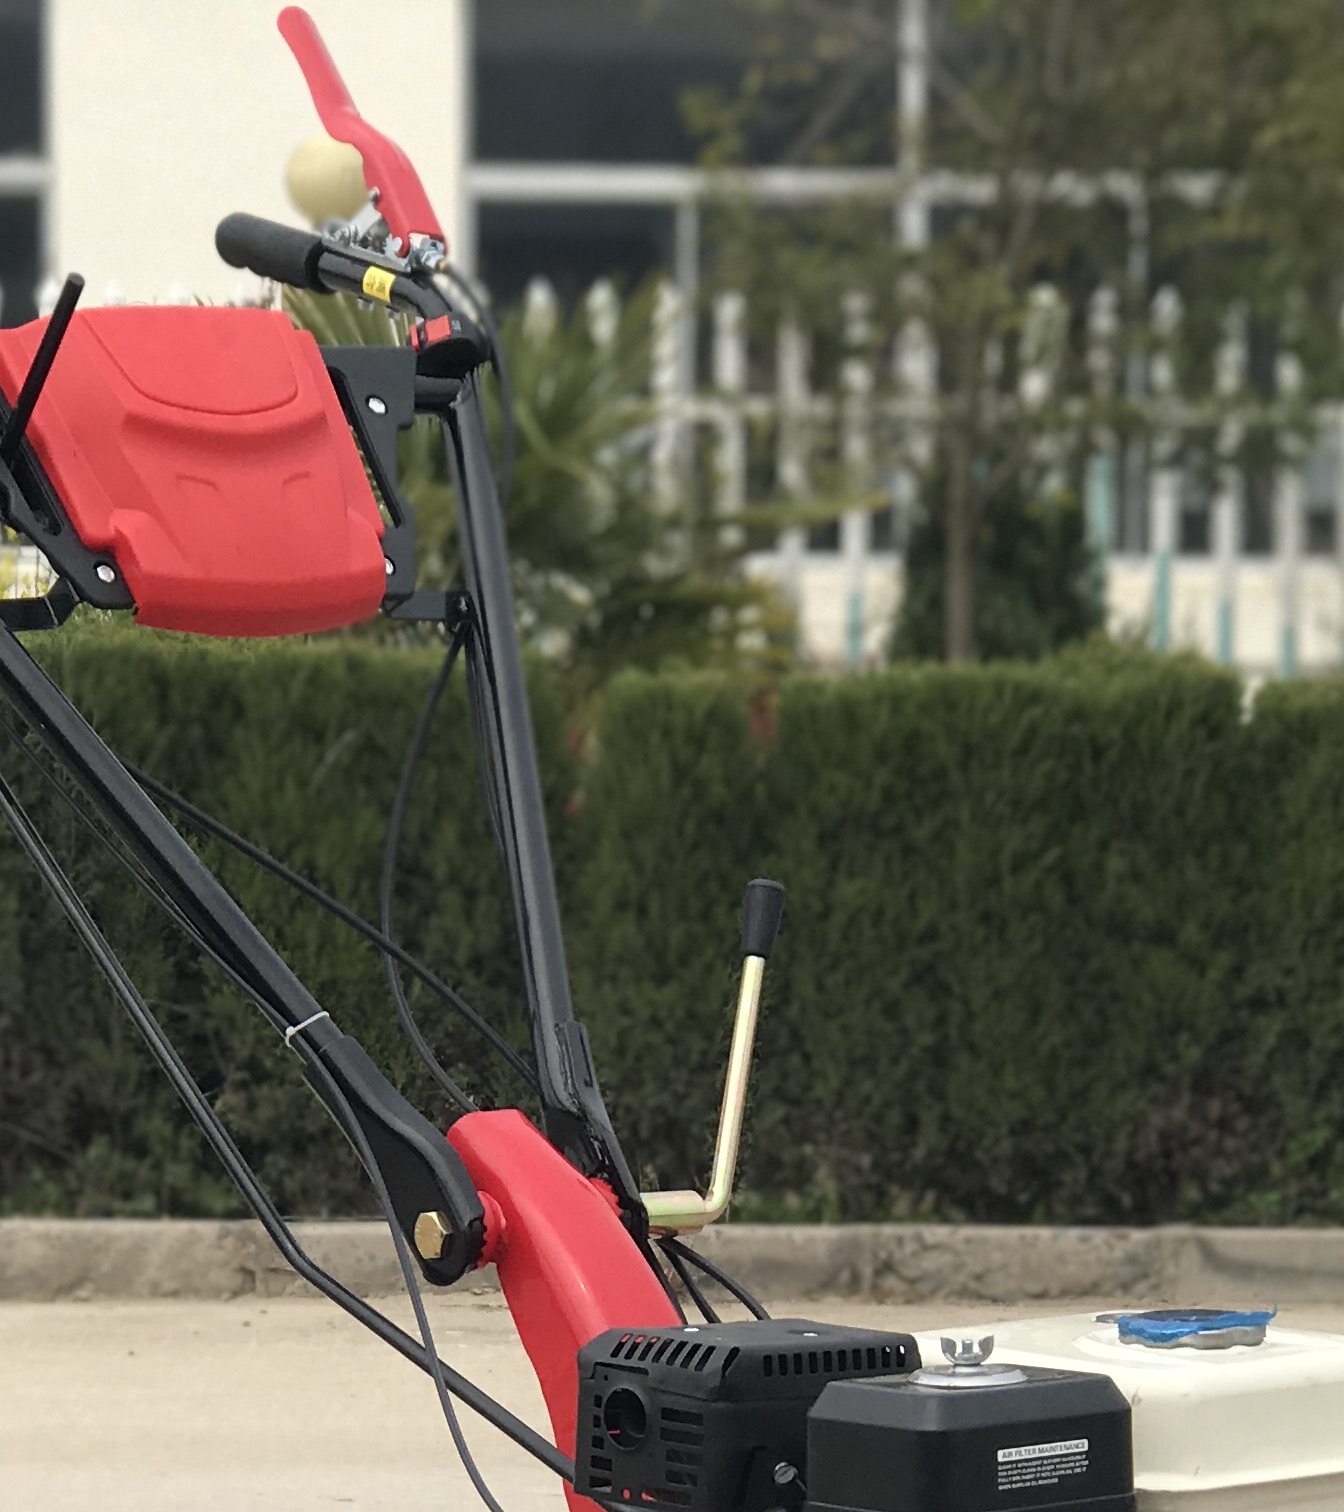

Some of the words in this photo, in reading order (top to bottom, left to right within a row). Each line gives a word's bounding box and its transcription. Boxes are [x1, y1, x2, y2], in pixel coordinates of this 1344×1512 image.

[1002, 1451, 1014, 1459] AIR
[1015, 1448, 1037, 1458] FILTER
[1038, 1442, 1086, 1454] MAINTENANCE
